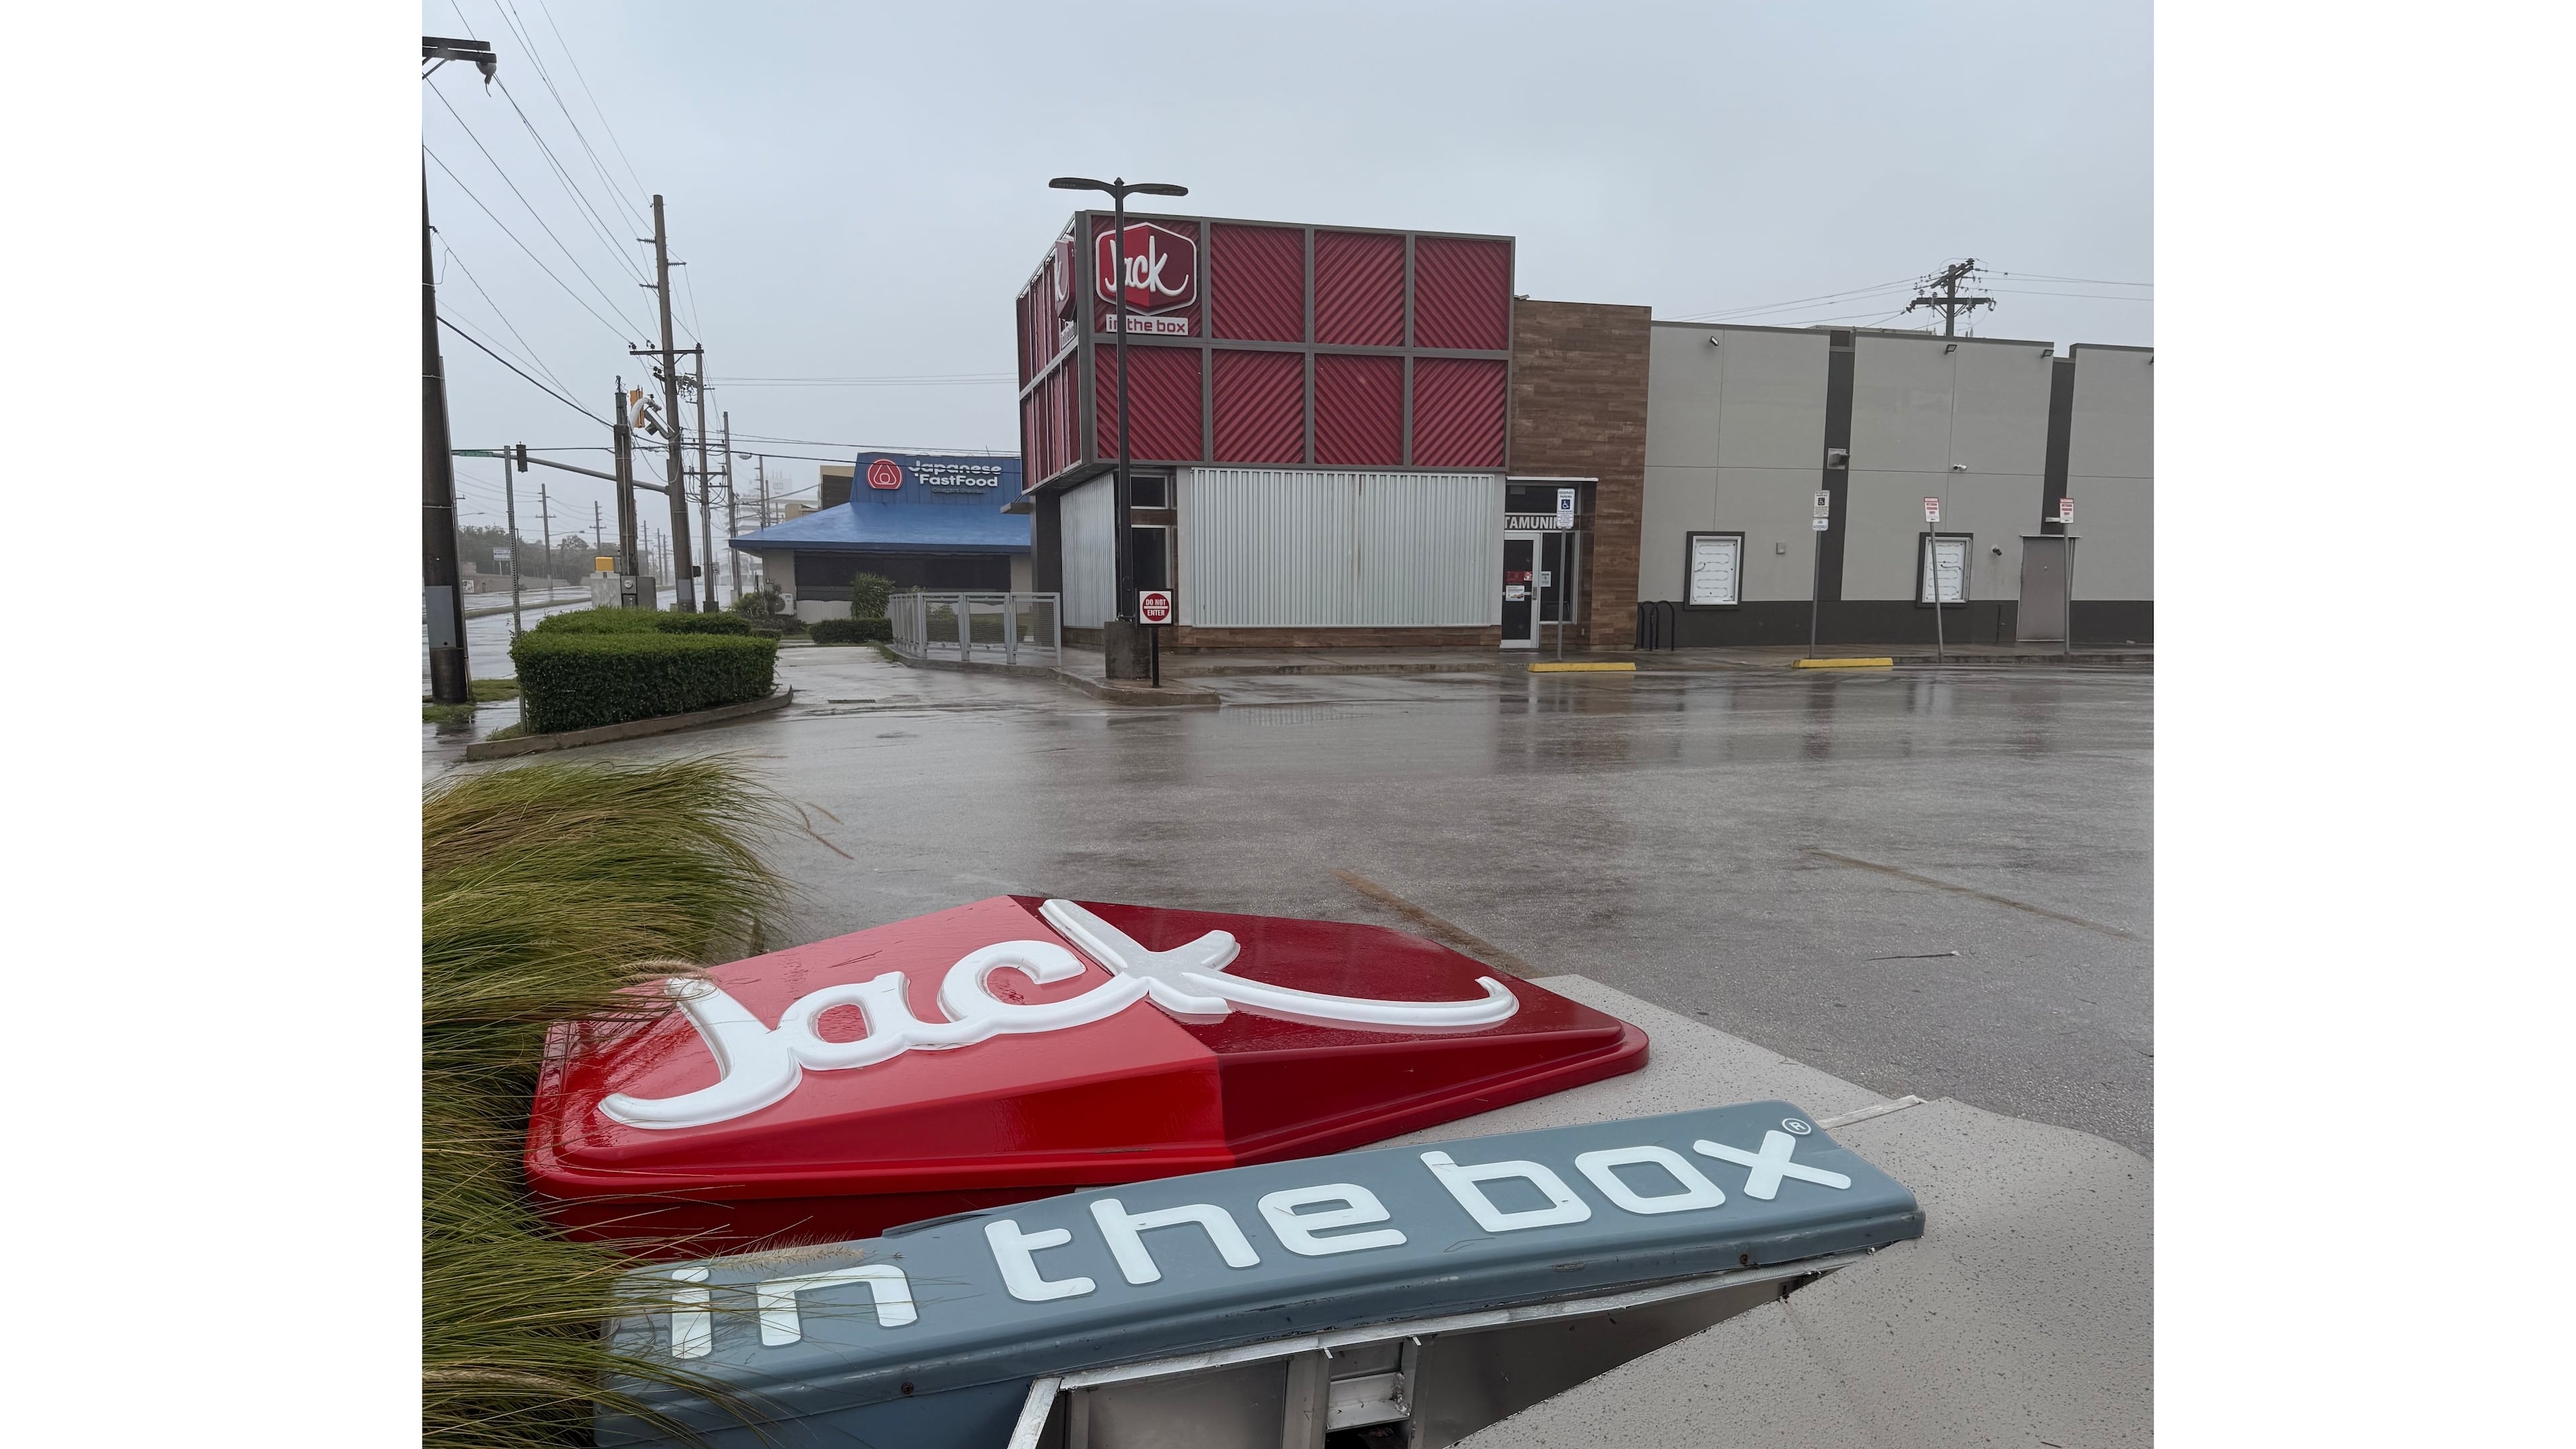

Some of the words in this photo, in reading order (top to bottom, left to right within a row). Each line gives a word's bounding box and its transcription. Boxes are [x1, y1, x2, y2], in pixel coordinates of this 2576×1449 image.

[1127, 318, 1152, 331] the
[1157, 320, 1185, 333] box
[908, 460, 1002, 475] Japanese
[597, 899, 1519, 1130] Jack
[672, 1264, 918, 1359] in
[984, 1183, 1408, 1301] the
[1419, 1130, 1851, 1232] box
